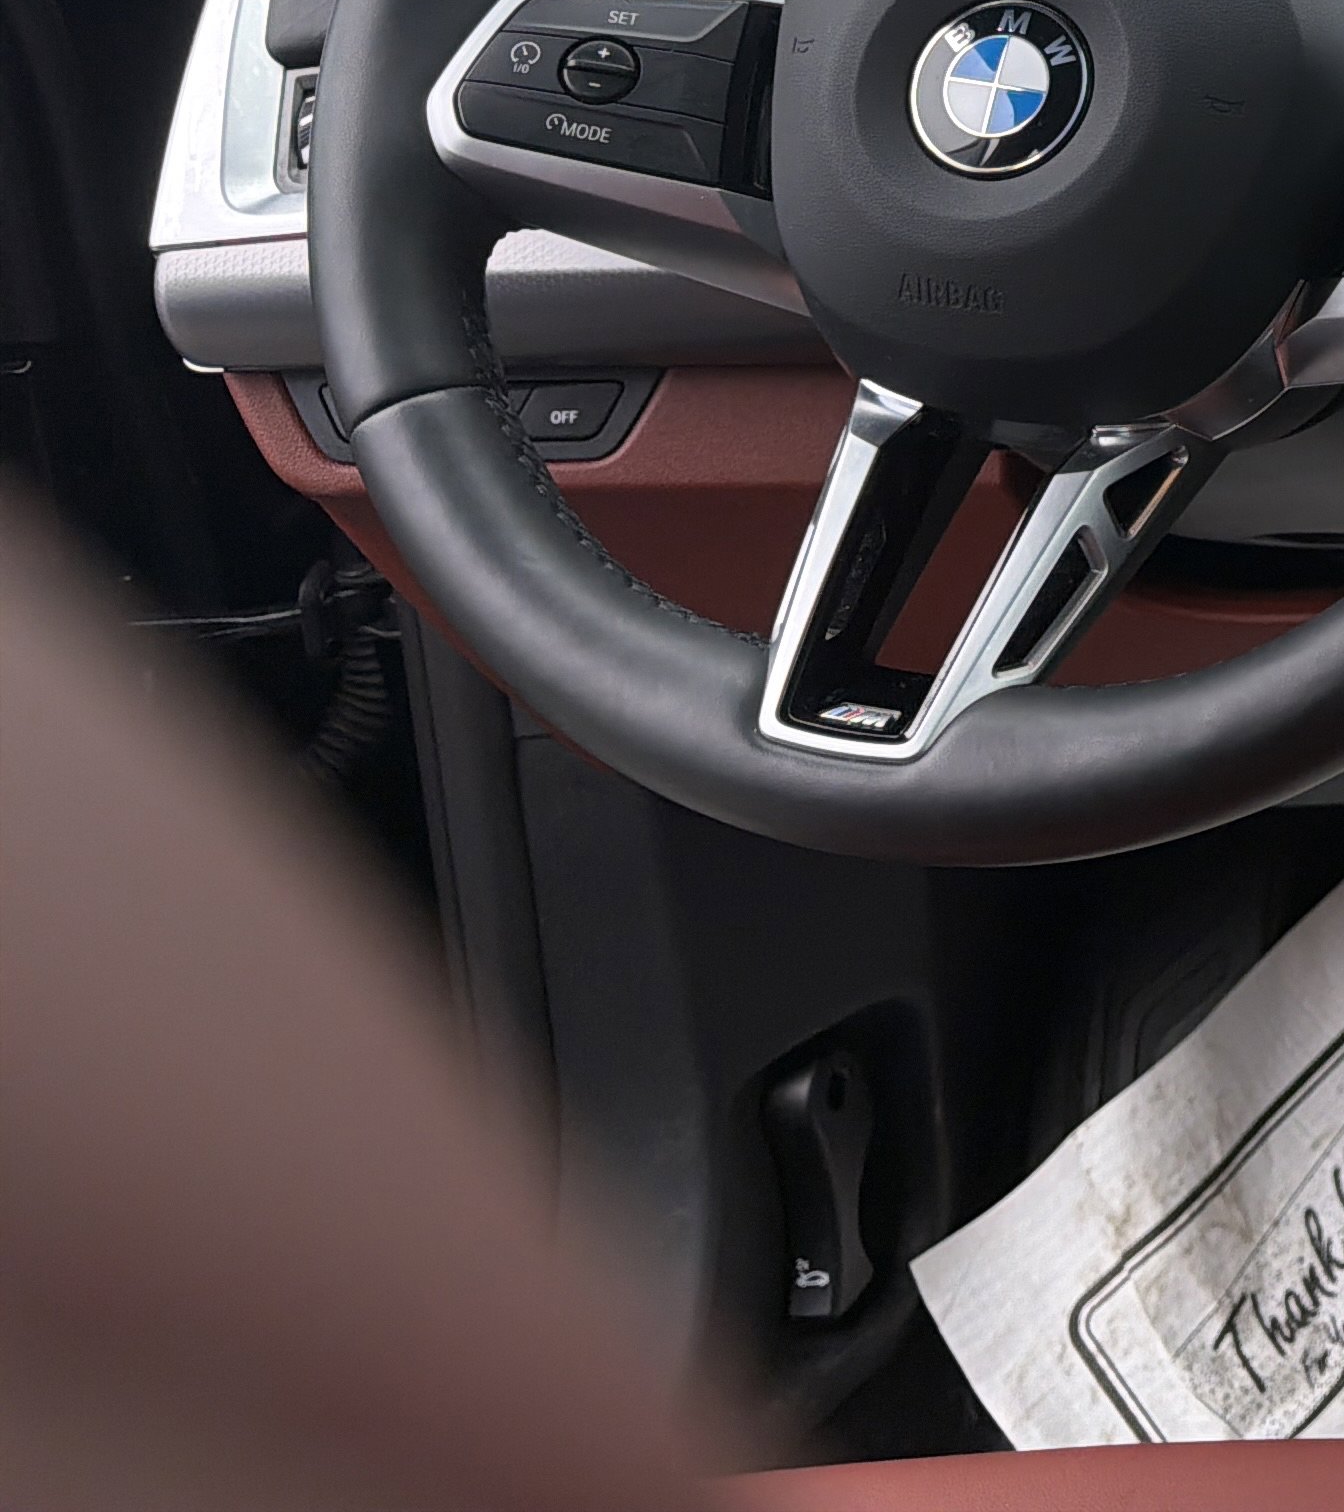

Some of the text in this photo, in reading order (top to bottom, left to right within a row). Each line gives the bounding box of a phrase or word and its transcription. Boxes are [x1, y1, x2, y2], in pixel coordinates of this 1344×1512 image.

[607, 9, 640, 27] SET
[943, 8, 1077, 68] BMW
[560, 120, 612, 145] MODE
[898, 273, 1003, 314] AIRBAG
[550, 409, 580, 425] OFF
